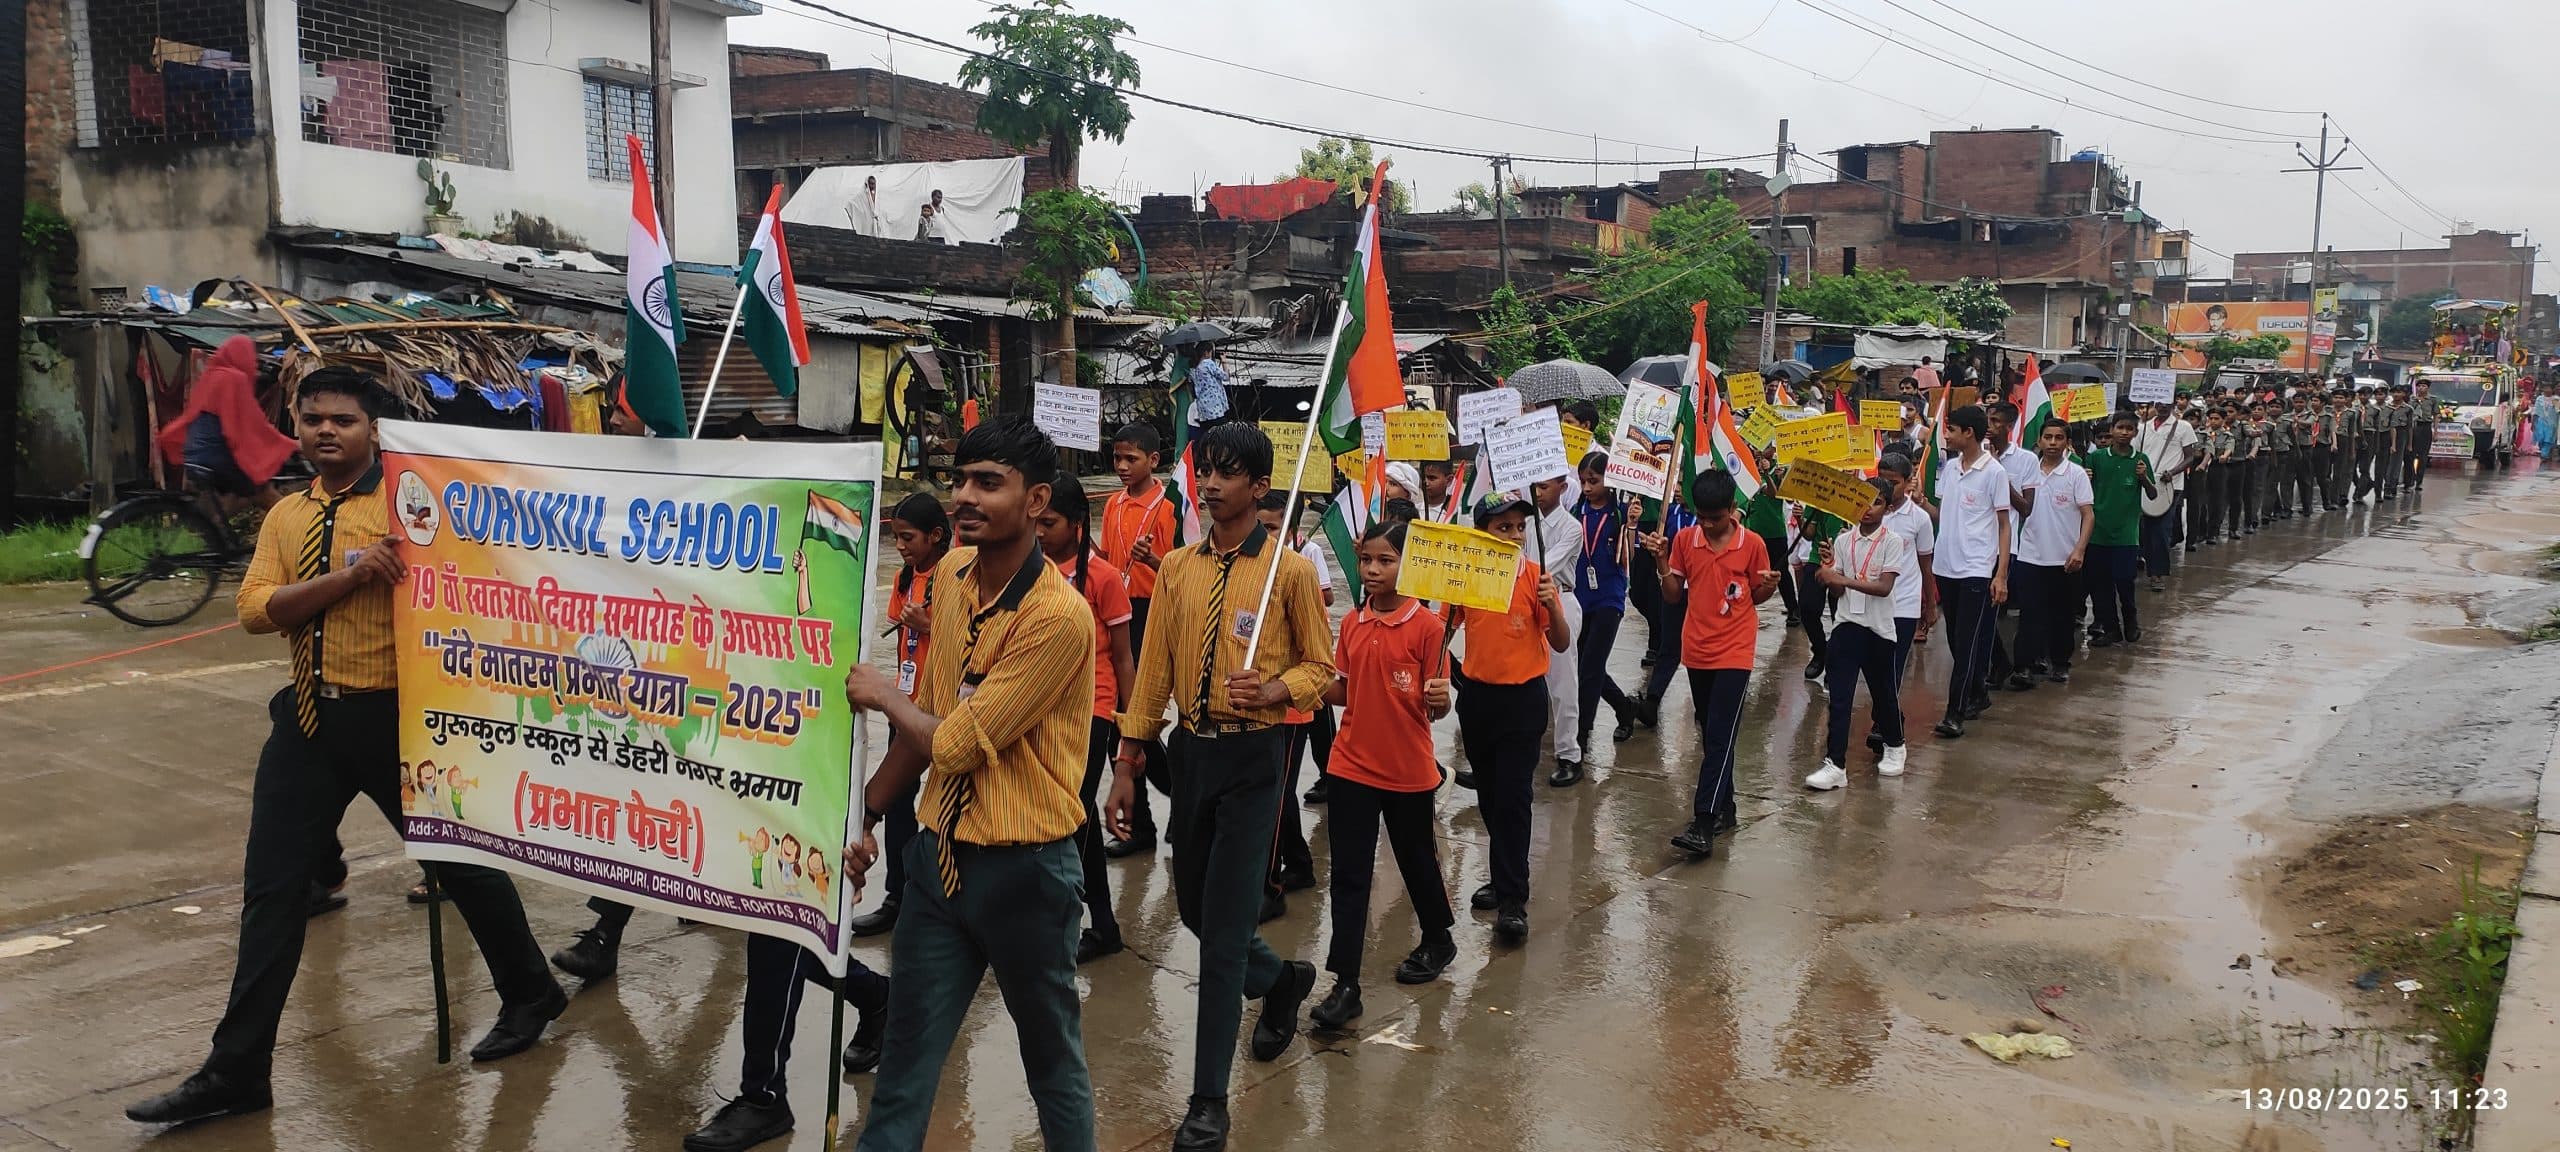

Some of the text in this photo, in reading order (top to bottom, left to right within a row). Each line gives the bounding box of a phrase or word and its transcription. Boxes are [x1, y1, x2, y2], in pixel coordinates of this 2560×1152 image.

[443, 480, 785, 573] GURUKUL SCHOOL
[1411, 535, 1431, 547] शिक्षा
[1435, 540, 1443, 549] से
[1463, 545, 1481, 556] भारत
[1486, 546, 1497, 558] की
[1411, 555, 1509, 579] गुरुकुल स्कूल है बच्चों का
[412, 566, 436, 609] 79
[535, 576, 598, 634] दिवस
[603, 588, 685, 645] समारोह
[690, 594, 714, 648] के
[721, 609, 795, 660] अवसर
[798, 618, 833, 666] पर
[478, 643, 564, 706] मातरम्
[563, 656, 624, 705] प्रभात
[627, 669, 688, 717] यात्रा
[726, 682, 821, 735] 2025"
[424, 709, 803, 806] गुरूकुल स्कूल से डेहरी नगर भ्रमण
[408, 820, 438, 836] Add:-
[441, 828, 458, 839] AT:
[526, 847, 571, 870] BADIHAN
[573, 856, 650, 892] SHANKARPURI,
[653, 877, 684, 898] DEHRI
[686, 887, 701, 902] ON
[703, 889, 741, 911] SONE,
[514, 770, 705, 877] (प्रभात फेरी)
